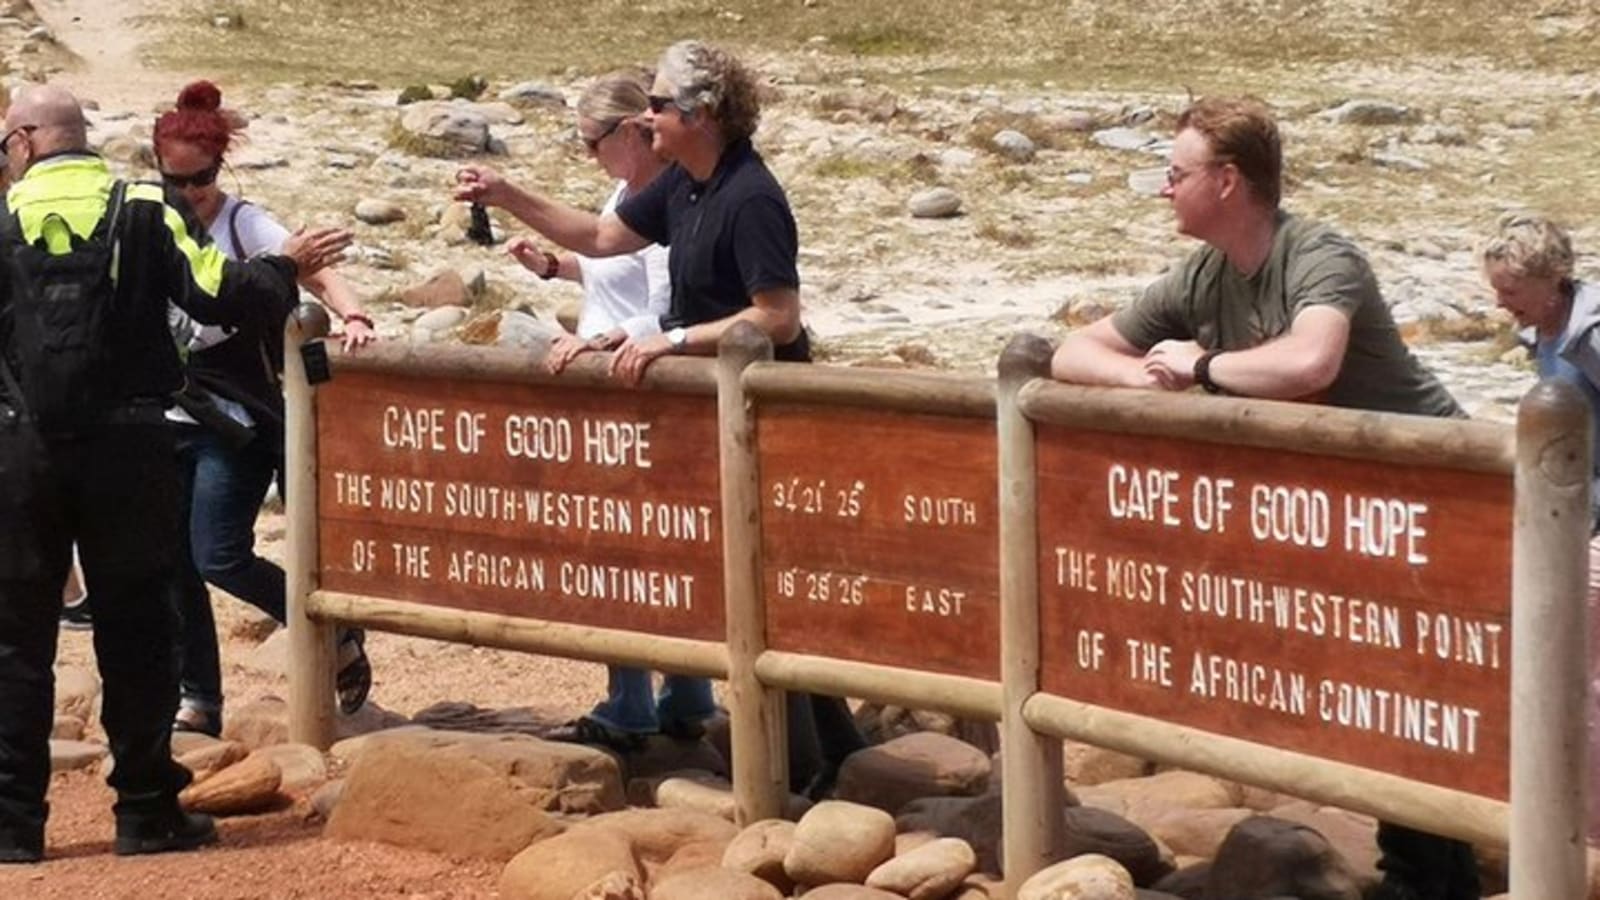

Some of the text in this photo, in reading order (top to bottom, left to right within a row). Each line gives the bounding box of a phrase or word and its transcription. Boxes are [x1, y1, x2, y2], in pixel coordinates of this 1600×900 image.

[383, 406, 653, 468] CAPE OF GOOD HOPE
[335, 472, 712, 543] THE MOST SOUTH-WESTERN POINT
[904, 494, 977, 525] SOUTH
[1108, 464, 1428, 564] CAPE OF GOOD HOPE
[352, 540, 695, 610] OF THE AFRICAN CONTINENT
[906, 585, 966, 617] EAST
[1055, 547, 1503, 669] THE MOST SOUTH-WESTERN POINT
[1077, 630, 1481, 755] OF THE AFRICAN CONTINENT
